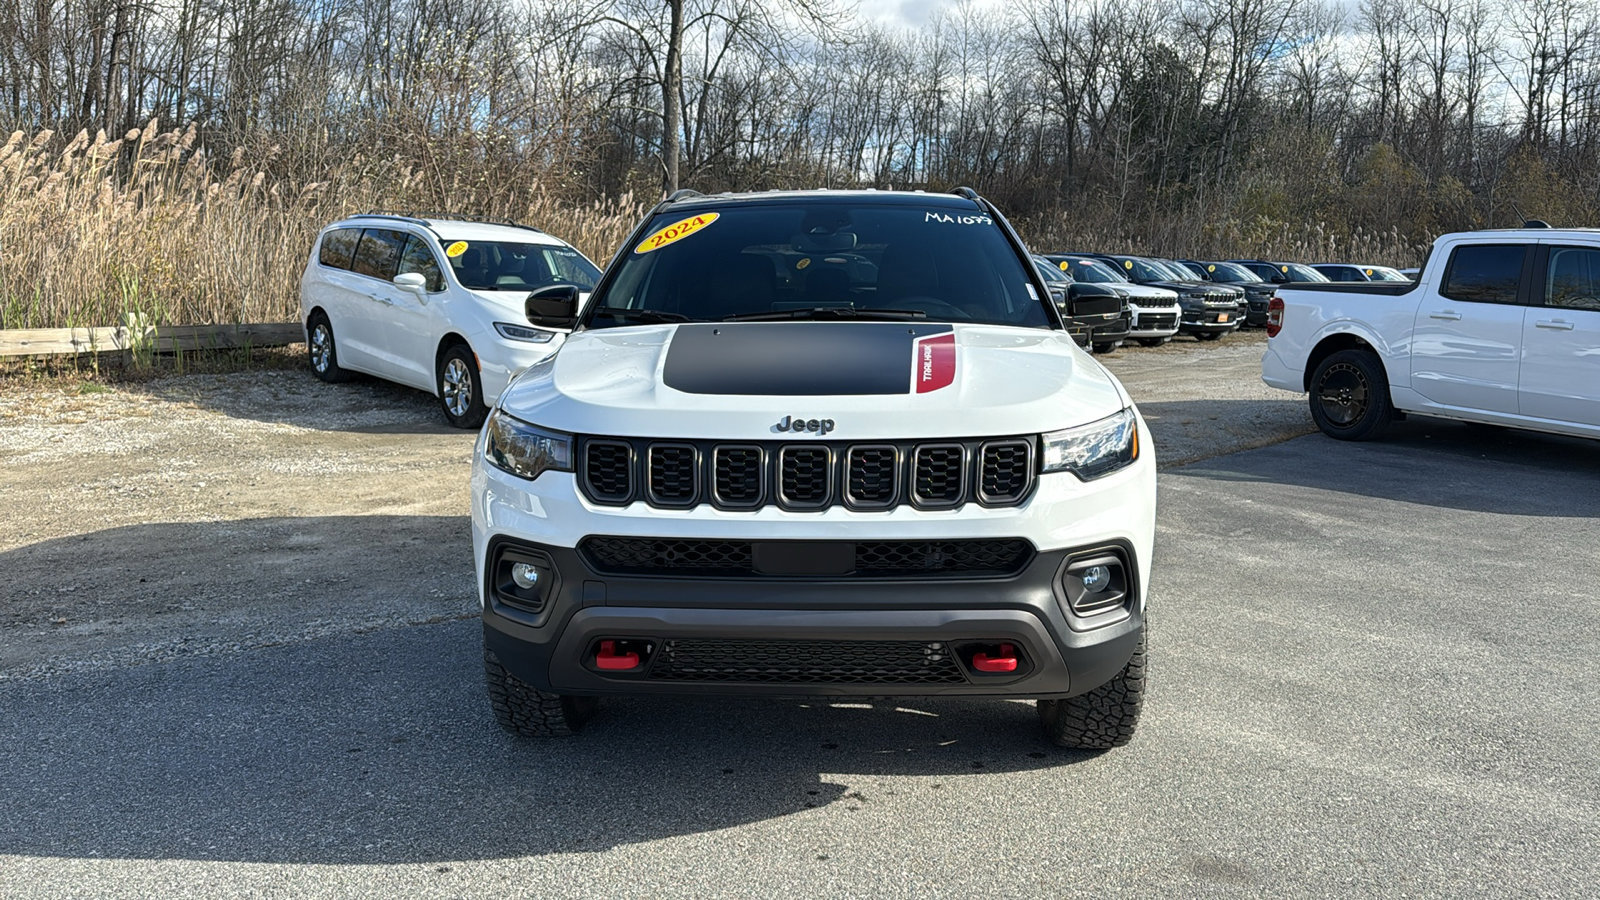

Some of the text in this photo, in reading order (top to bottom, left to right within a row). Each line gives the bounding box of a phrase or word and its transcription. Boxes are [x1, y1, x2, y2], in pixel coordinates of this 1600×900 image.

[651, 216, 705, 247] 2024
[922, 344, 932, 382] TRAILHAWK
[776, 415, 835, 435] Jeep
